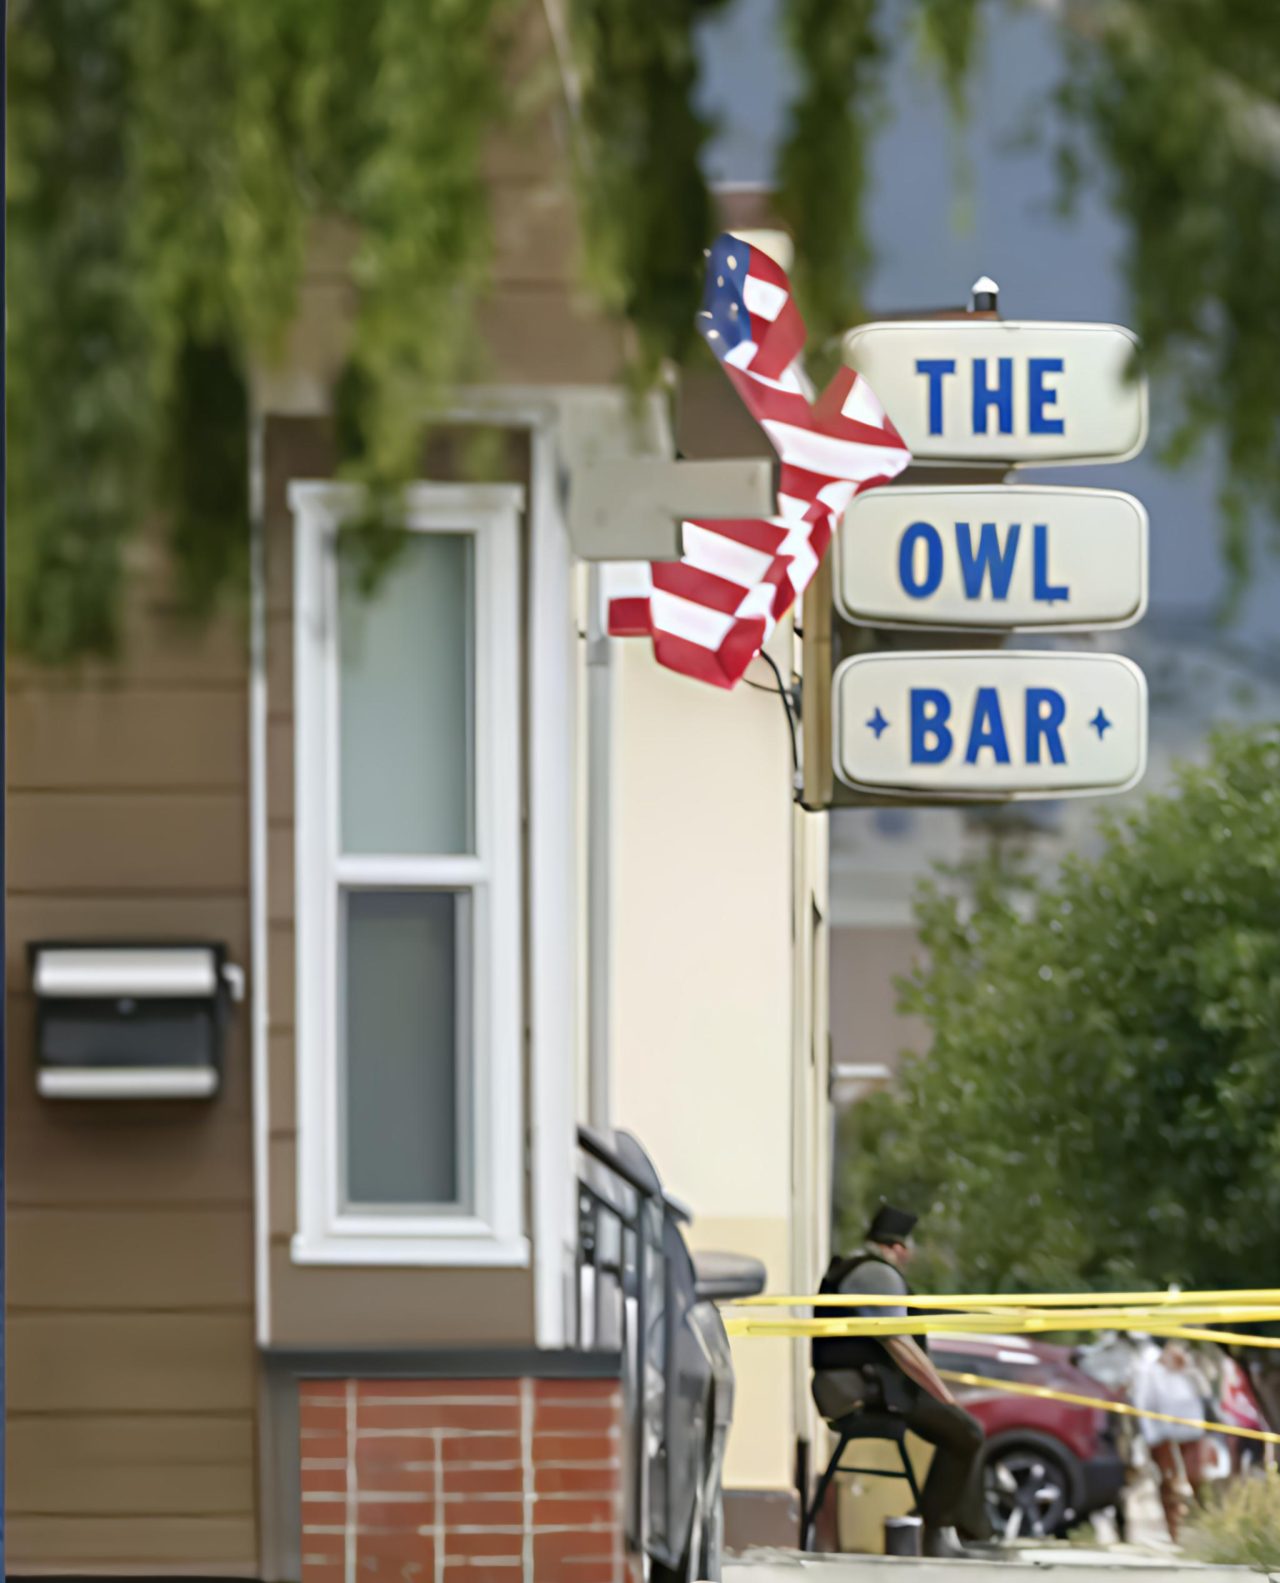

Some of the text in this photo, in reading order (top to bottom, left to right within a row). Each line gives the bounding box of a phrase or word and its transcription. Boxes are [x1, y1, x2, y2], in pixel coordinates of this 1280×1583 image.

[917, 358, 1064, 434] THE
[900, 523, 1068, 601] OWL
[911, 688, 1065, 764] BAR
